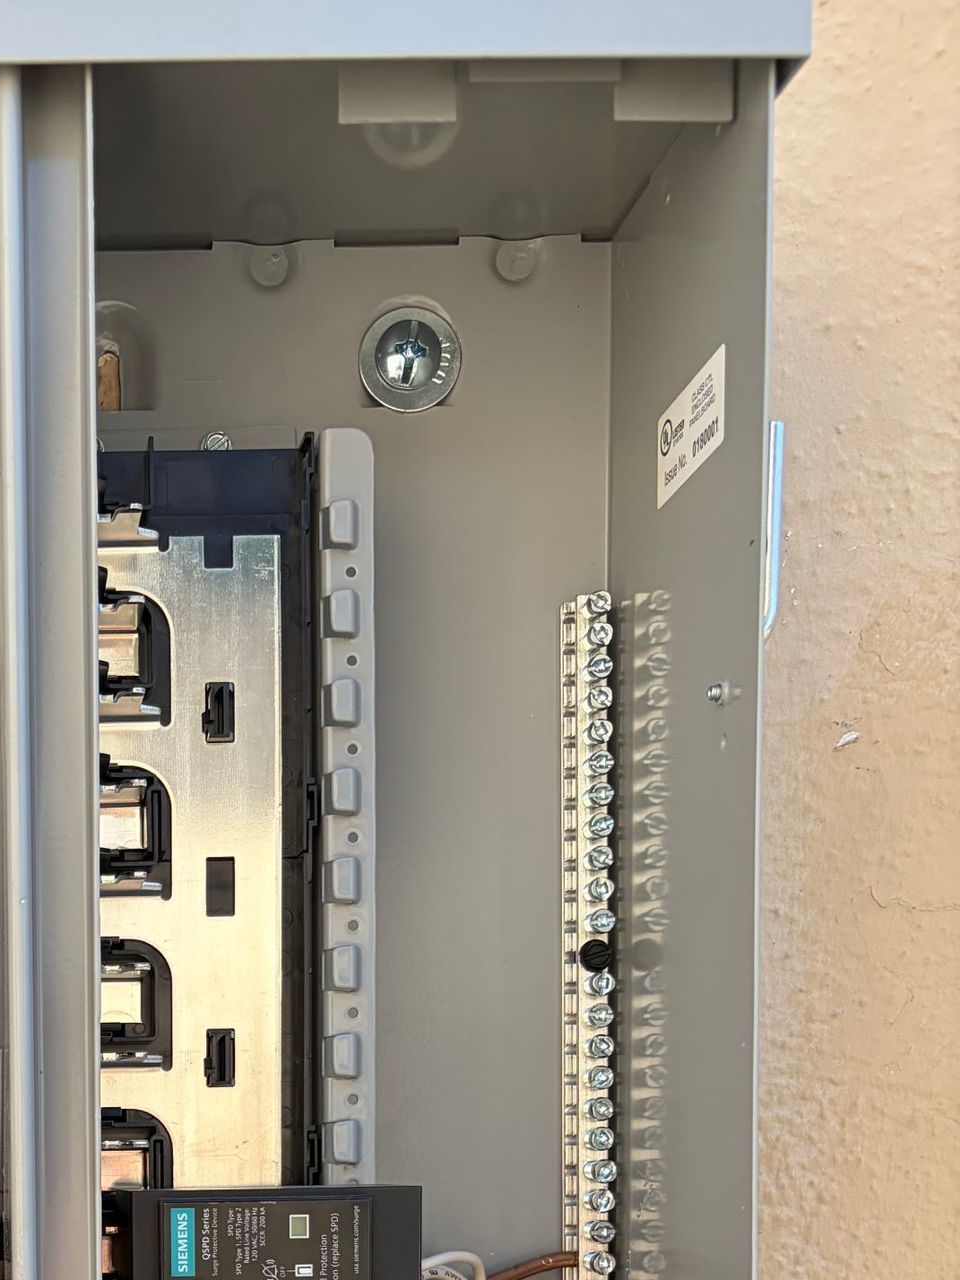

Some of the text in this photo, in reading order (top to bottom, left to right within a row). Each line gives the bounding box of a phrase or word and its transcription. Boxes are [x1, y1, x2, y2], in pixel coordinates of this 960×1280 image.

[665, 464, 677, 487] Issue
[678, 453, 687, 472] No.
[693, 416, 718, 457] 0180001
[252, 1207, 257, 1215] Hz
[330, 1212, 340, 1232] SPD)
[177, 1213, 188, 1272] SIEMENS
[202, 1237, 210, 1260] QSPD
[320, 1234, 328, 1276] Protection
[331, 1234, 340, 1267] (replace
